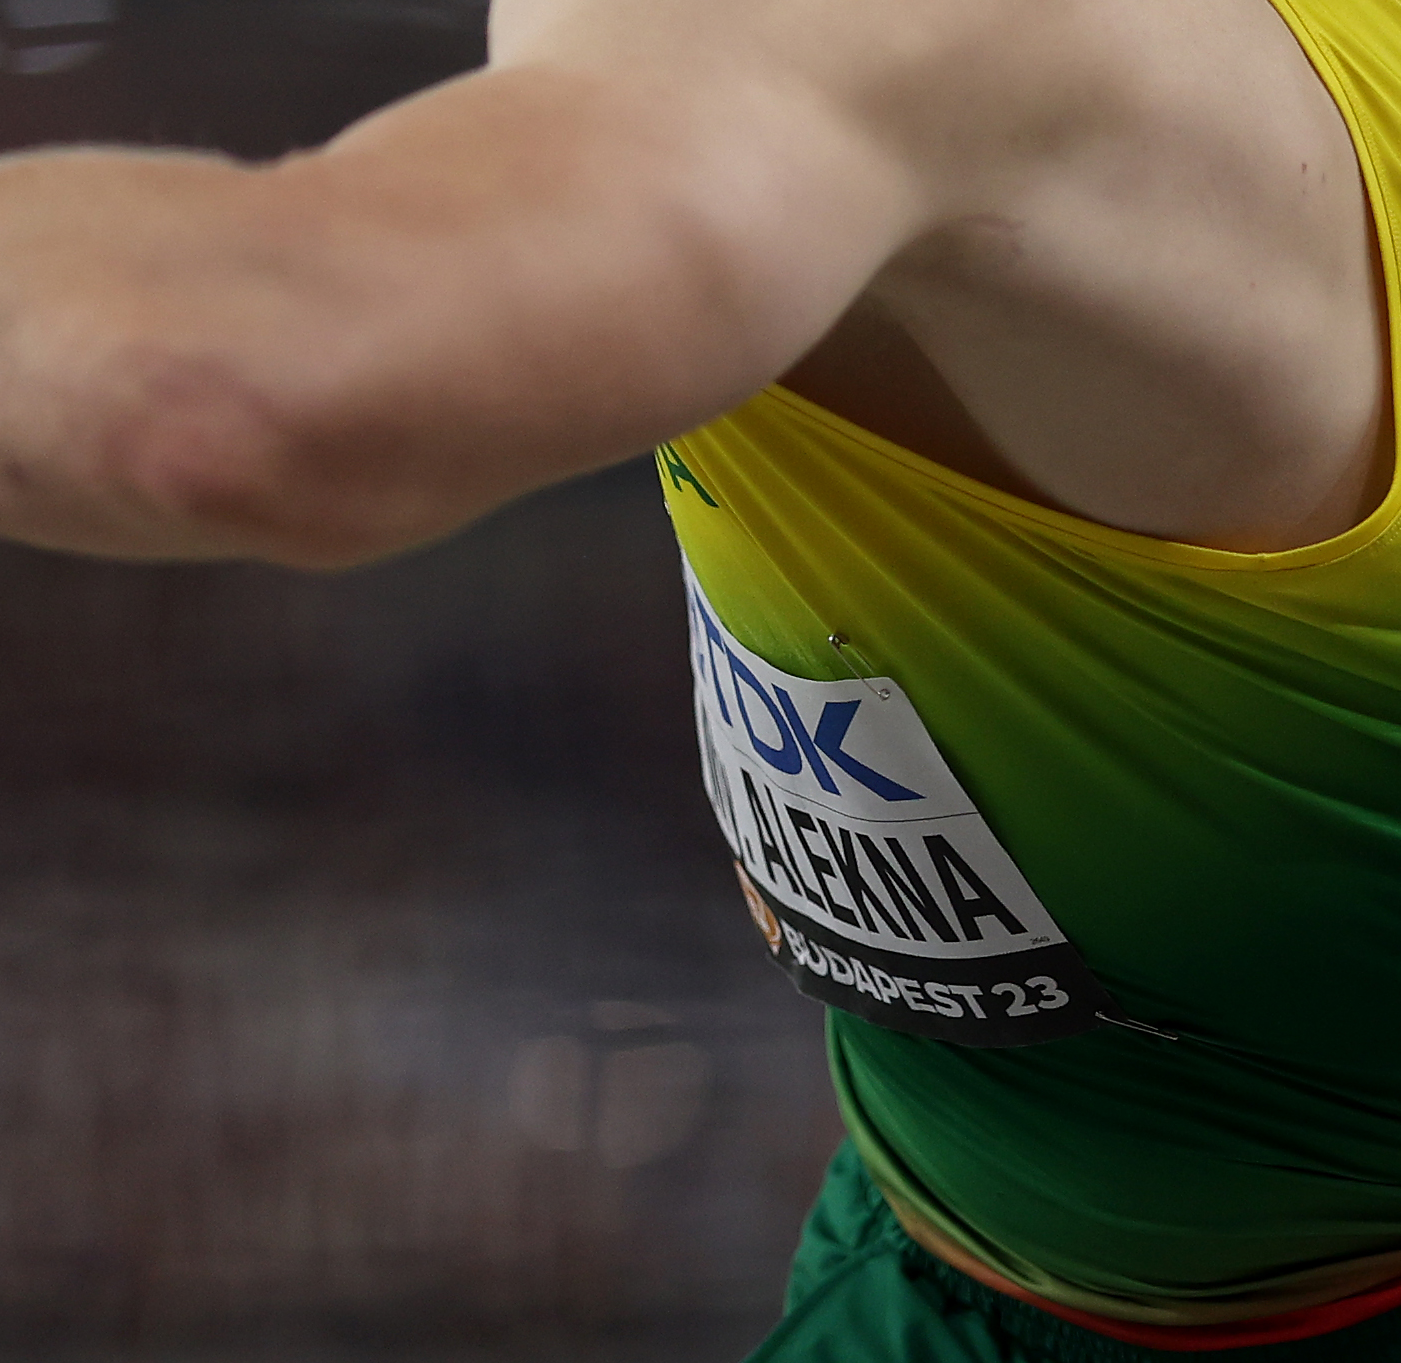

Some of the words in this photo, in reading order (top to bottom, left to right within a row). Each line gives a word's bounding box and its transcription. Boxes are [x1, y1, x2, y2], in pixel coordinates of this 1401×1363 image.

[655, 442, 719, 509] A
[692, 582, 927, 802] TDK
[741, 767, 1028, 943] ALEKNA
[779, 918, 987, 1019] BUDAPEST
[990, 975, 1070, 1017] 23
